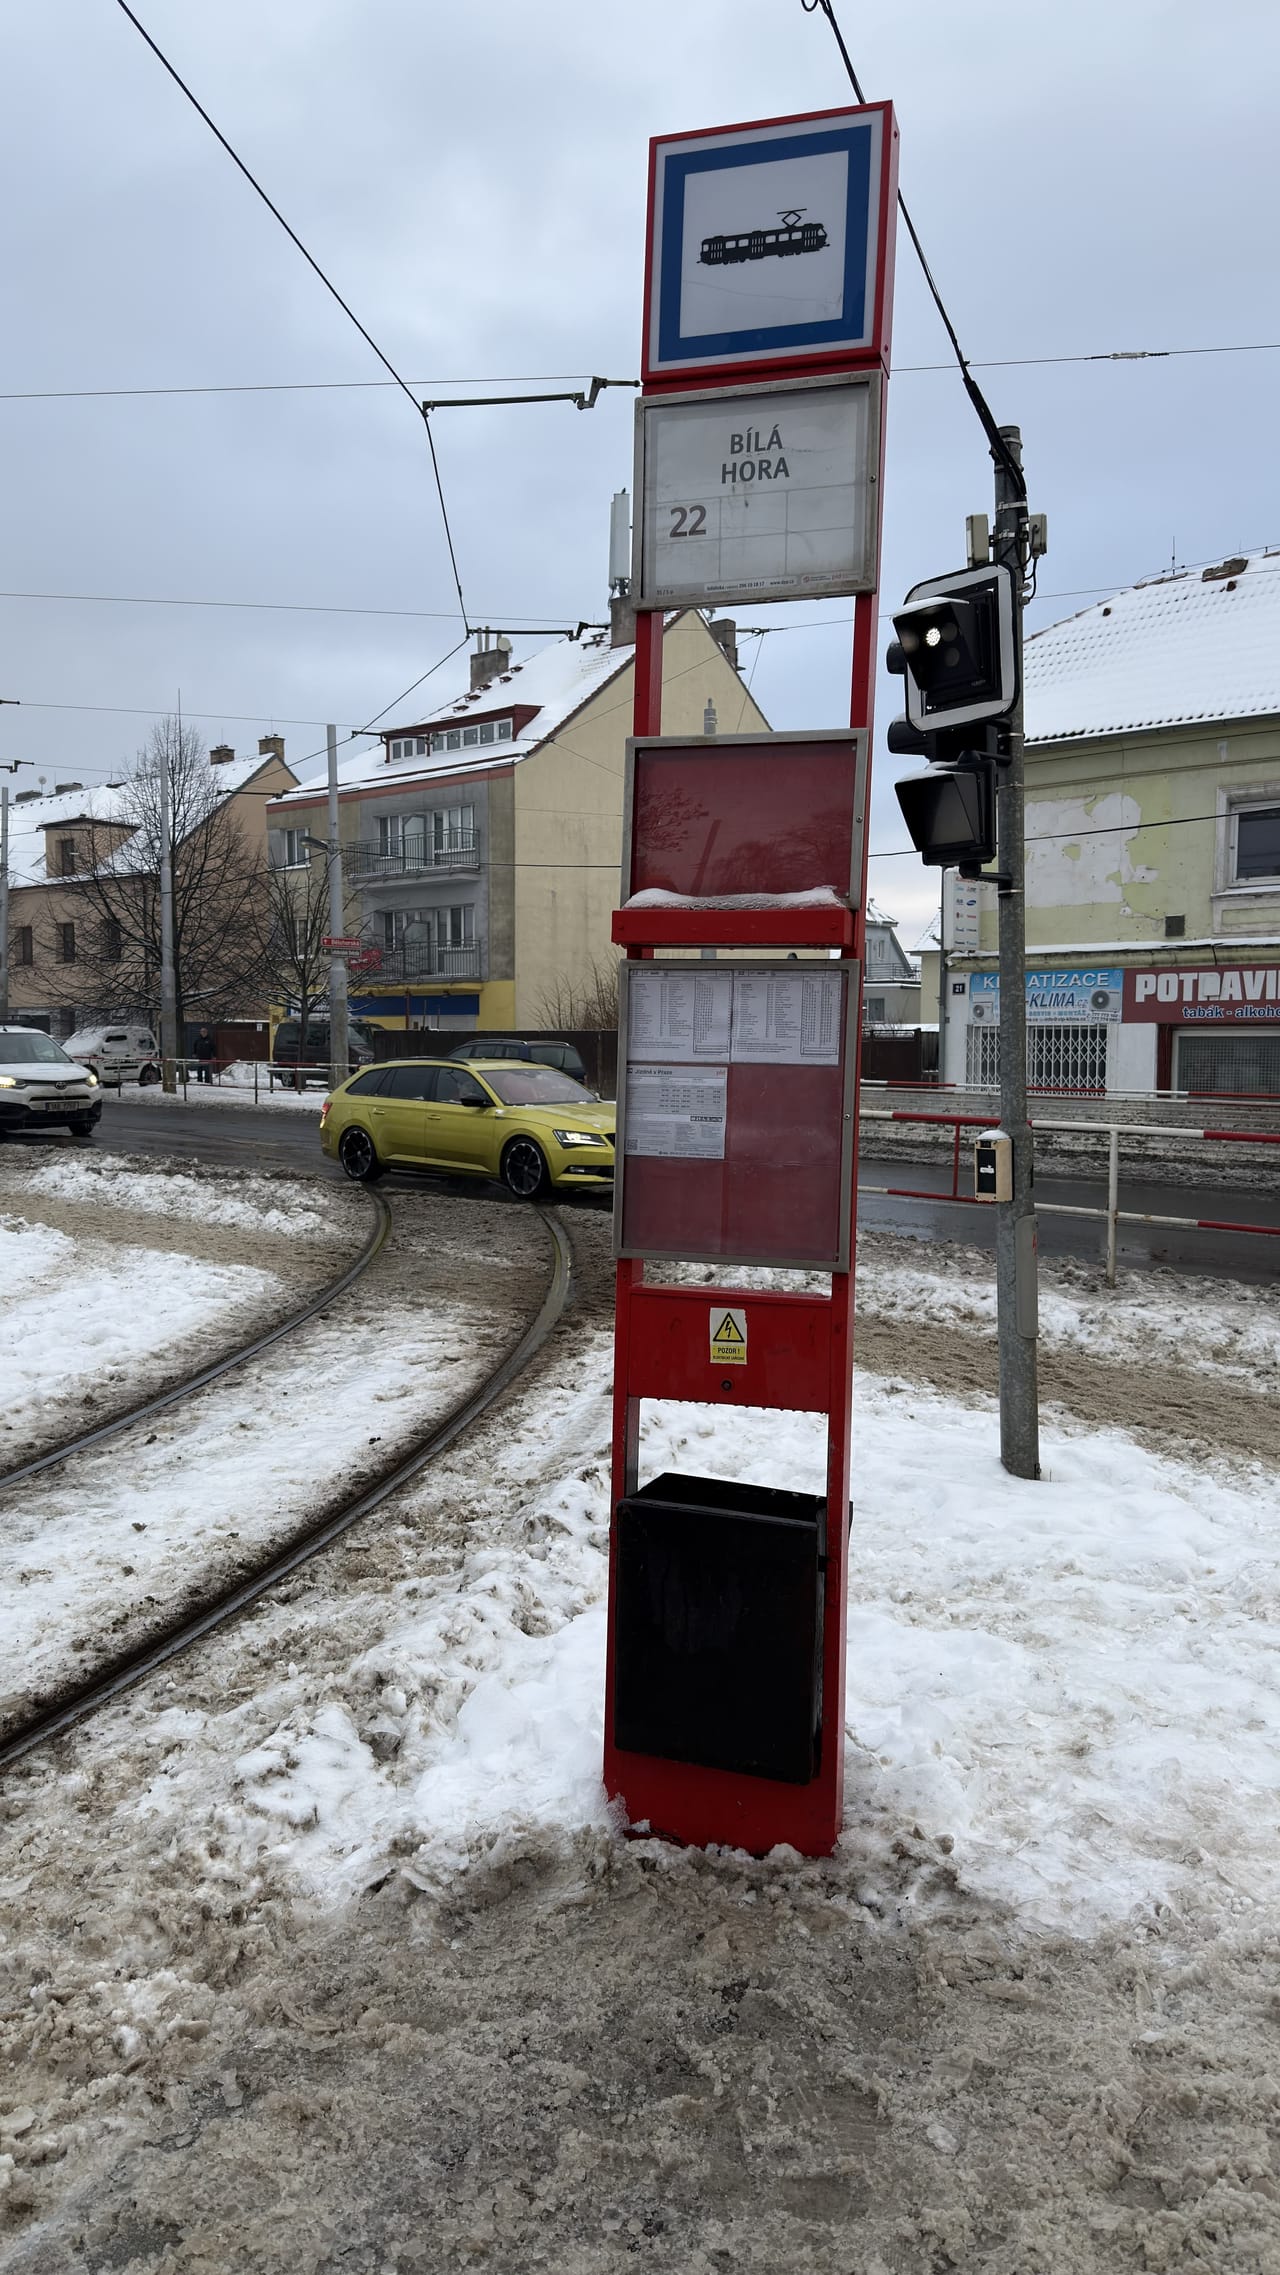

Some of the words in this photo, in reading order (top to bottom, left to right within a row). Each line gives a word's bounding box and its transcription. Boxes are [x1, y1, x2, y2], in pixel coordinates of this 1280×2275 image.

[730, 424, 783, 455] BÍLÁ
[721, 457, 790, 484] HORA
[669, 504, 707, 538] 22
[1183, 1005, 1225, 1018] tabák
